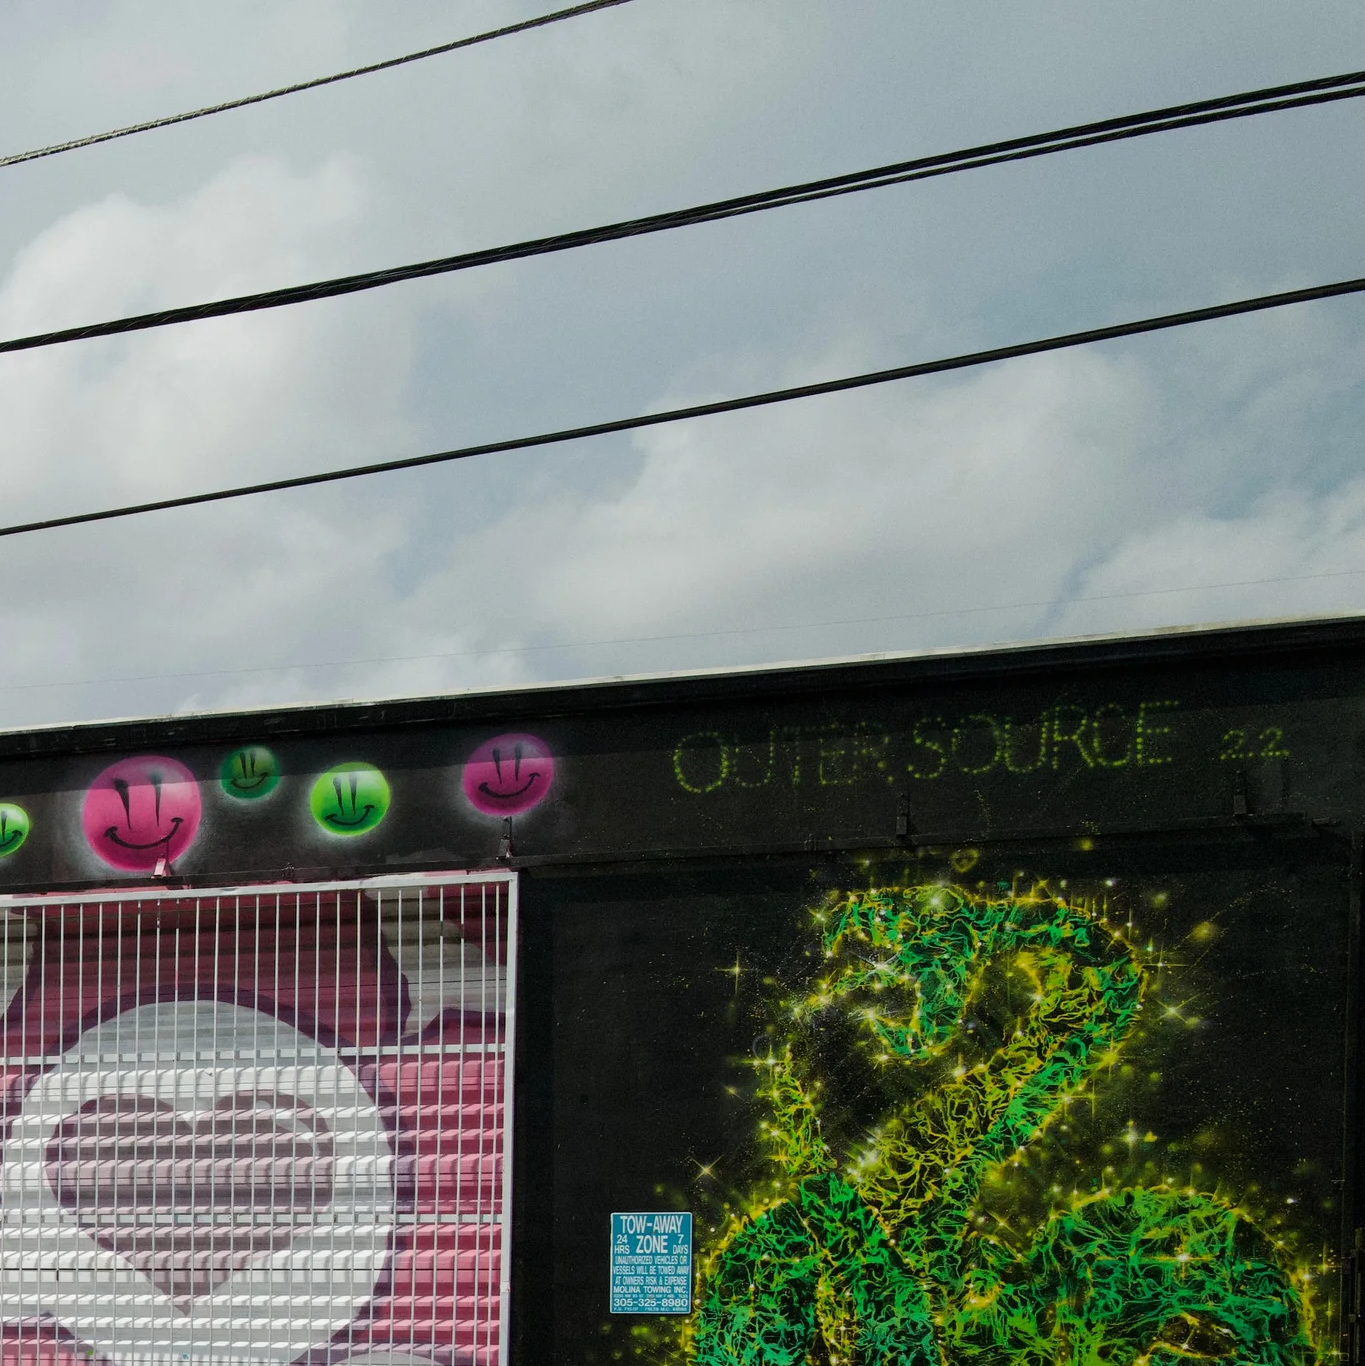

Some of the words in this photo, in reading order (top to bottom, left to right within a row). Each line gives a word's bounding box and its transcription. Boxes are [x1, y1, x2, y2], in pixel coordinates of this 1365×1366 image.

[673, 722, 893, 793] OUTER
[907, 702, 1180, 780] SOURCE
[620, 1215, 683, 1234] TOW-AWAY
[616, 1234, 628, 1244] 24
[635, 1235, 669, 1254] ZONE
[677, 1234, 684, 1244] 7
[614, 1245, 630, 1255] HRS
[672, 1245, 689, 1255] DAYS
[615, 1255, 653, 1265] UNAUTHORIZED
[654, 1255, 679, 1265] VEHICLES
[679, 1255, 687, 1265] OR
[613, 1265, 635, 1275] VESSELS
[636, 1265, 648, 1275] WILL
[649, 1265, 657, 1275] BE
[657, 1265, 675, 1275] TOWED
[677, 1265, 689, 1275] AWAY
[615, 1275, 621, 1285] AT
[622, 1275, 644, 1285] OWNERS
[645, 1275, 658, 1285] RISK
[664, 1275, 688, 1285] EXPENSE
[613, 1286, 641, 1294] MOLINA
[643, 1286, 672, 1294] TOWING
[673, 1286, 689, 1294] INC.
[613, 1298, 689, 1307] 305-325-8980
